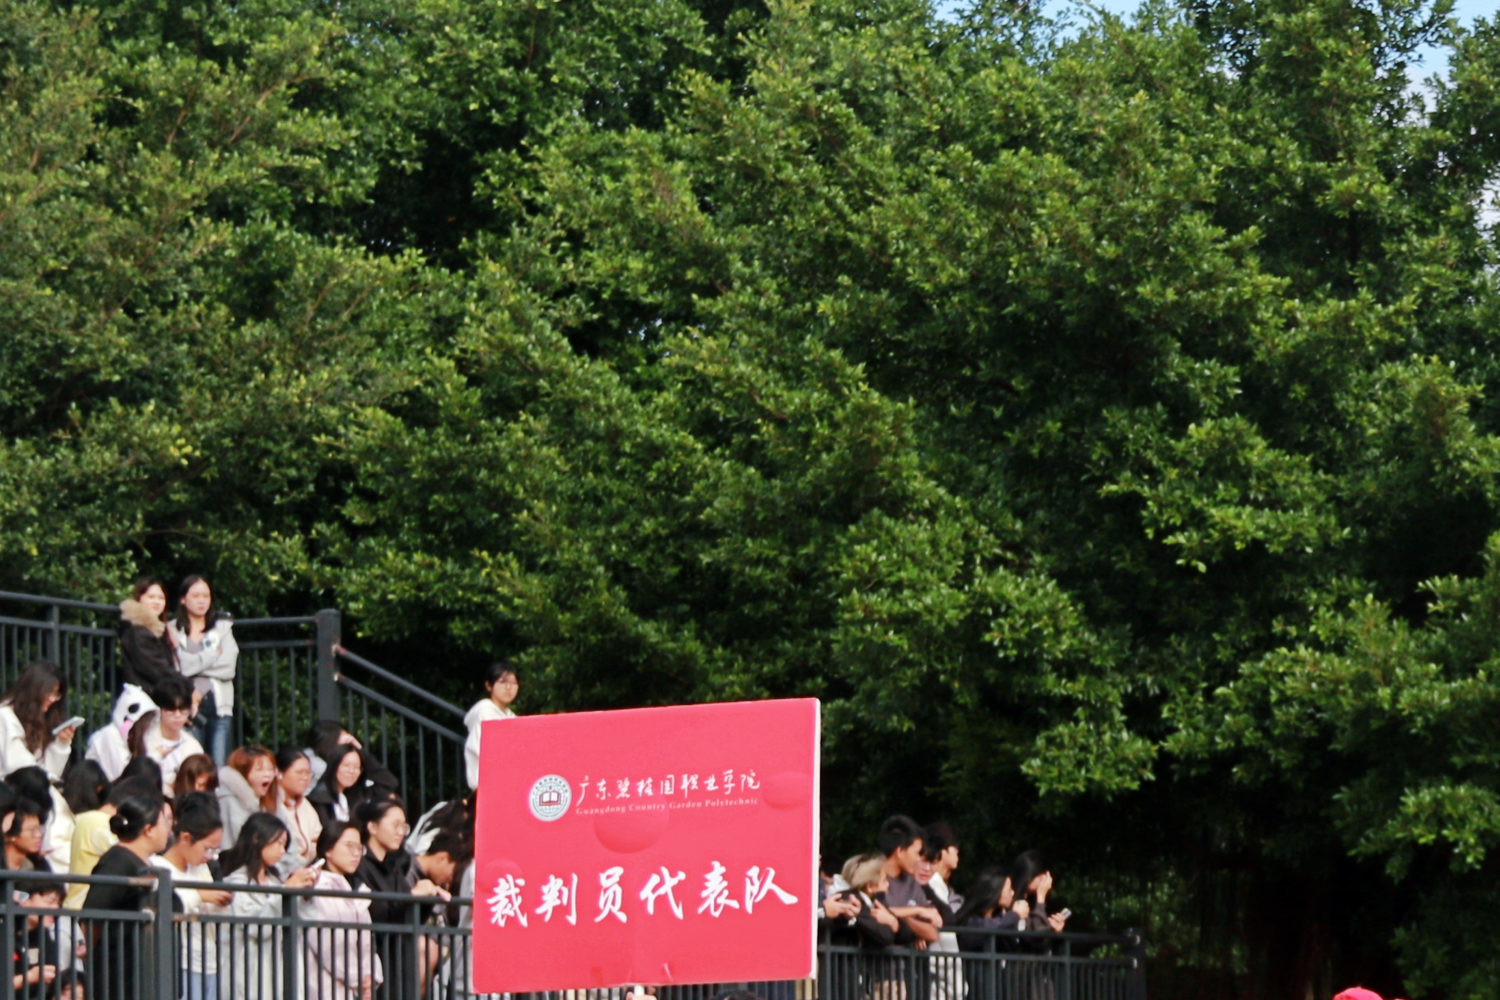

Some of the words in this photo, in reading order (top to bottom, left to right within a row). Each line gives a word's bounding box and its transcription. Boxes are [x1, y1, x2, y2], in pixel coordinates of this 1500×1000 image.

[576, 769, 761, 806] 广东碧桂园职业学院
[576, 803, 626, 815] Guangdong
[629, 801, 666, 811] Country
[669, 800, 702, 809] Garden
[705, 797, 758, 808] Polytechnic
[486, 861, 798, 928] 裁判员代表队
